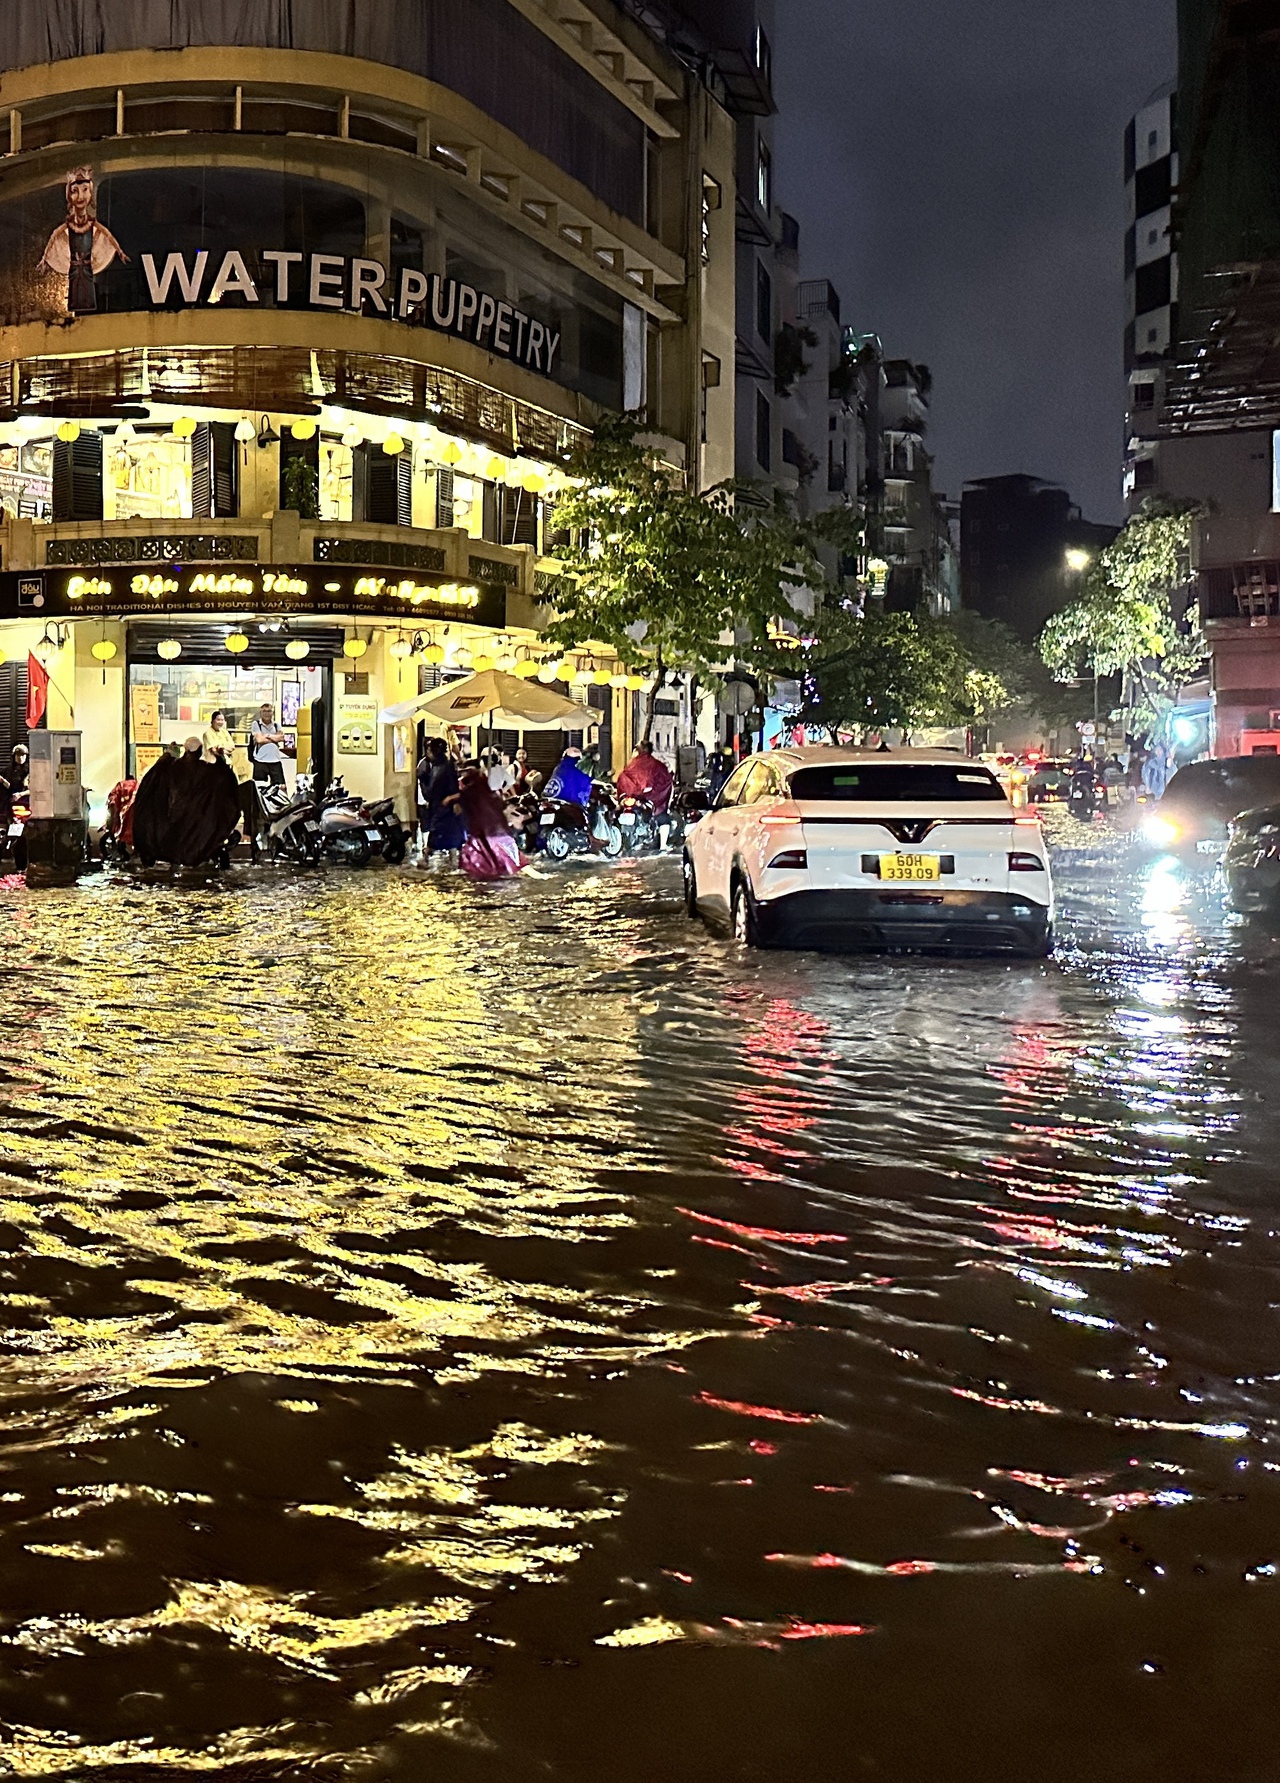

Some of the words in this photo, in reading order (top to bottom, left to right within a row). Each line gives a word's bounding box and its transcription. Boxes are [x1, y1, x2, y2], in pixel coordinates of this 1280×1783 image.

[141, 250, 388, 312] WATER
[399, 267, 560, 374] PUPPETRY
[352, 603, 376, 611] HCMC
